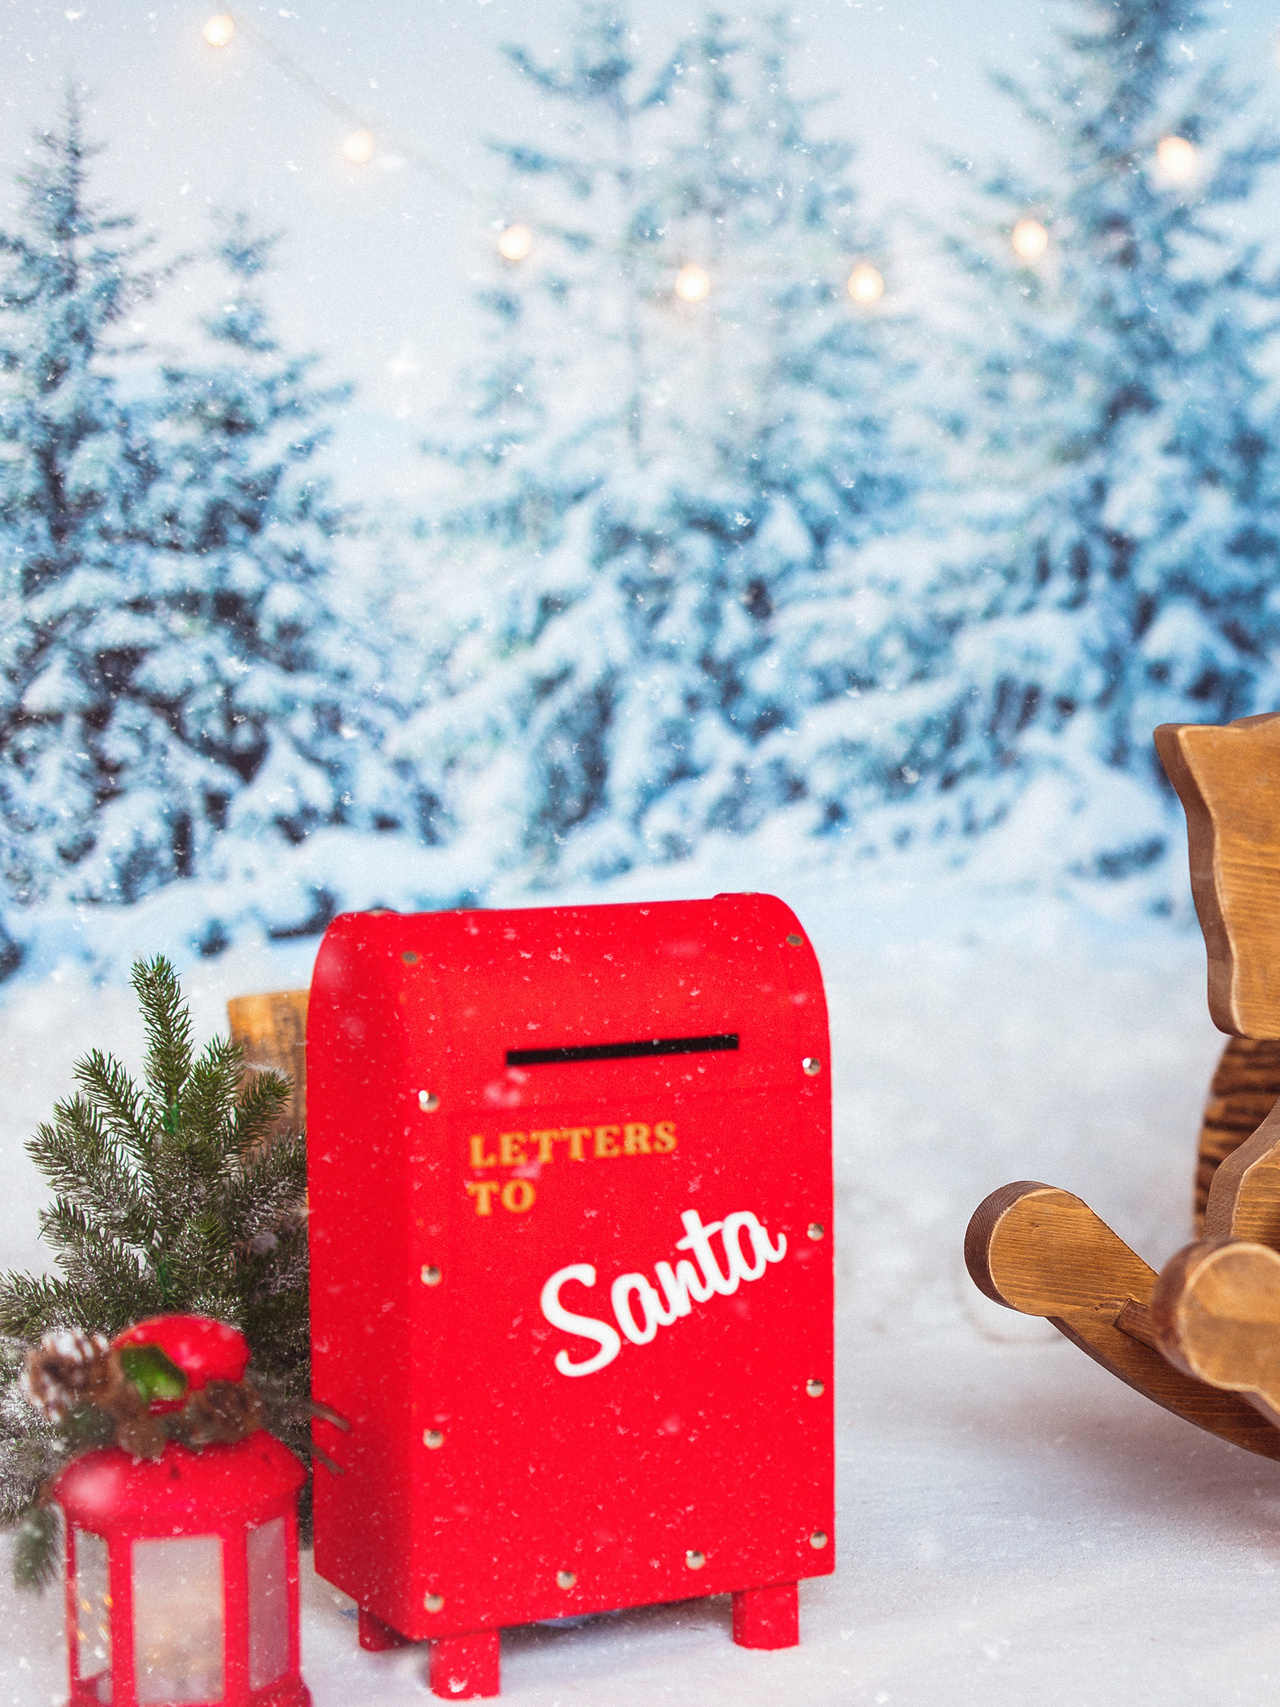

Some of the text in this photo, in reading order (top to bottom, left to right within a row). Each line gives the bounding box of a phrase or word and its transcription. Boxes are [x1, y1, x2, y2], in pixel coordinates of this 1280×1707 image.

[469, 1121, 678, 1168] LETTERS
[468, 1179, 537, 1216] TO
[541, 1209, 787, 1377] Santa
